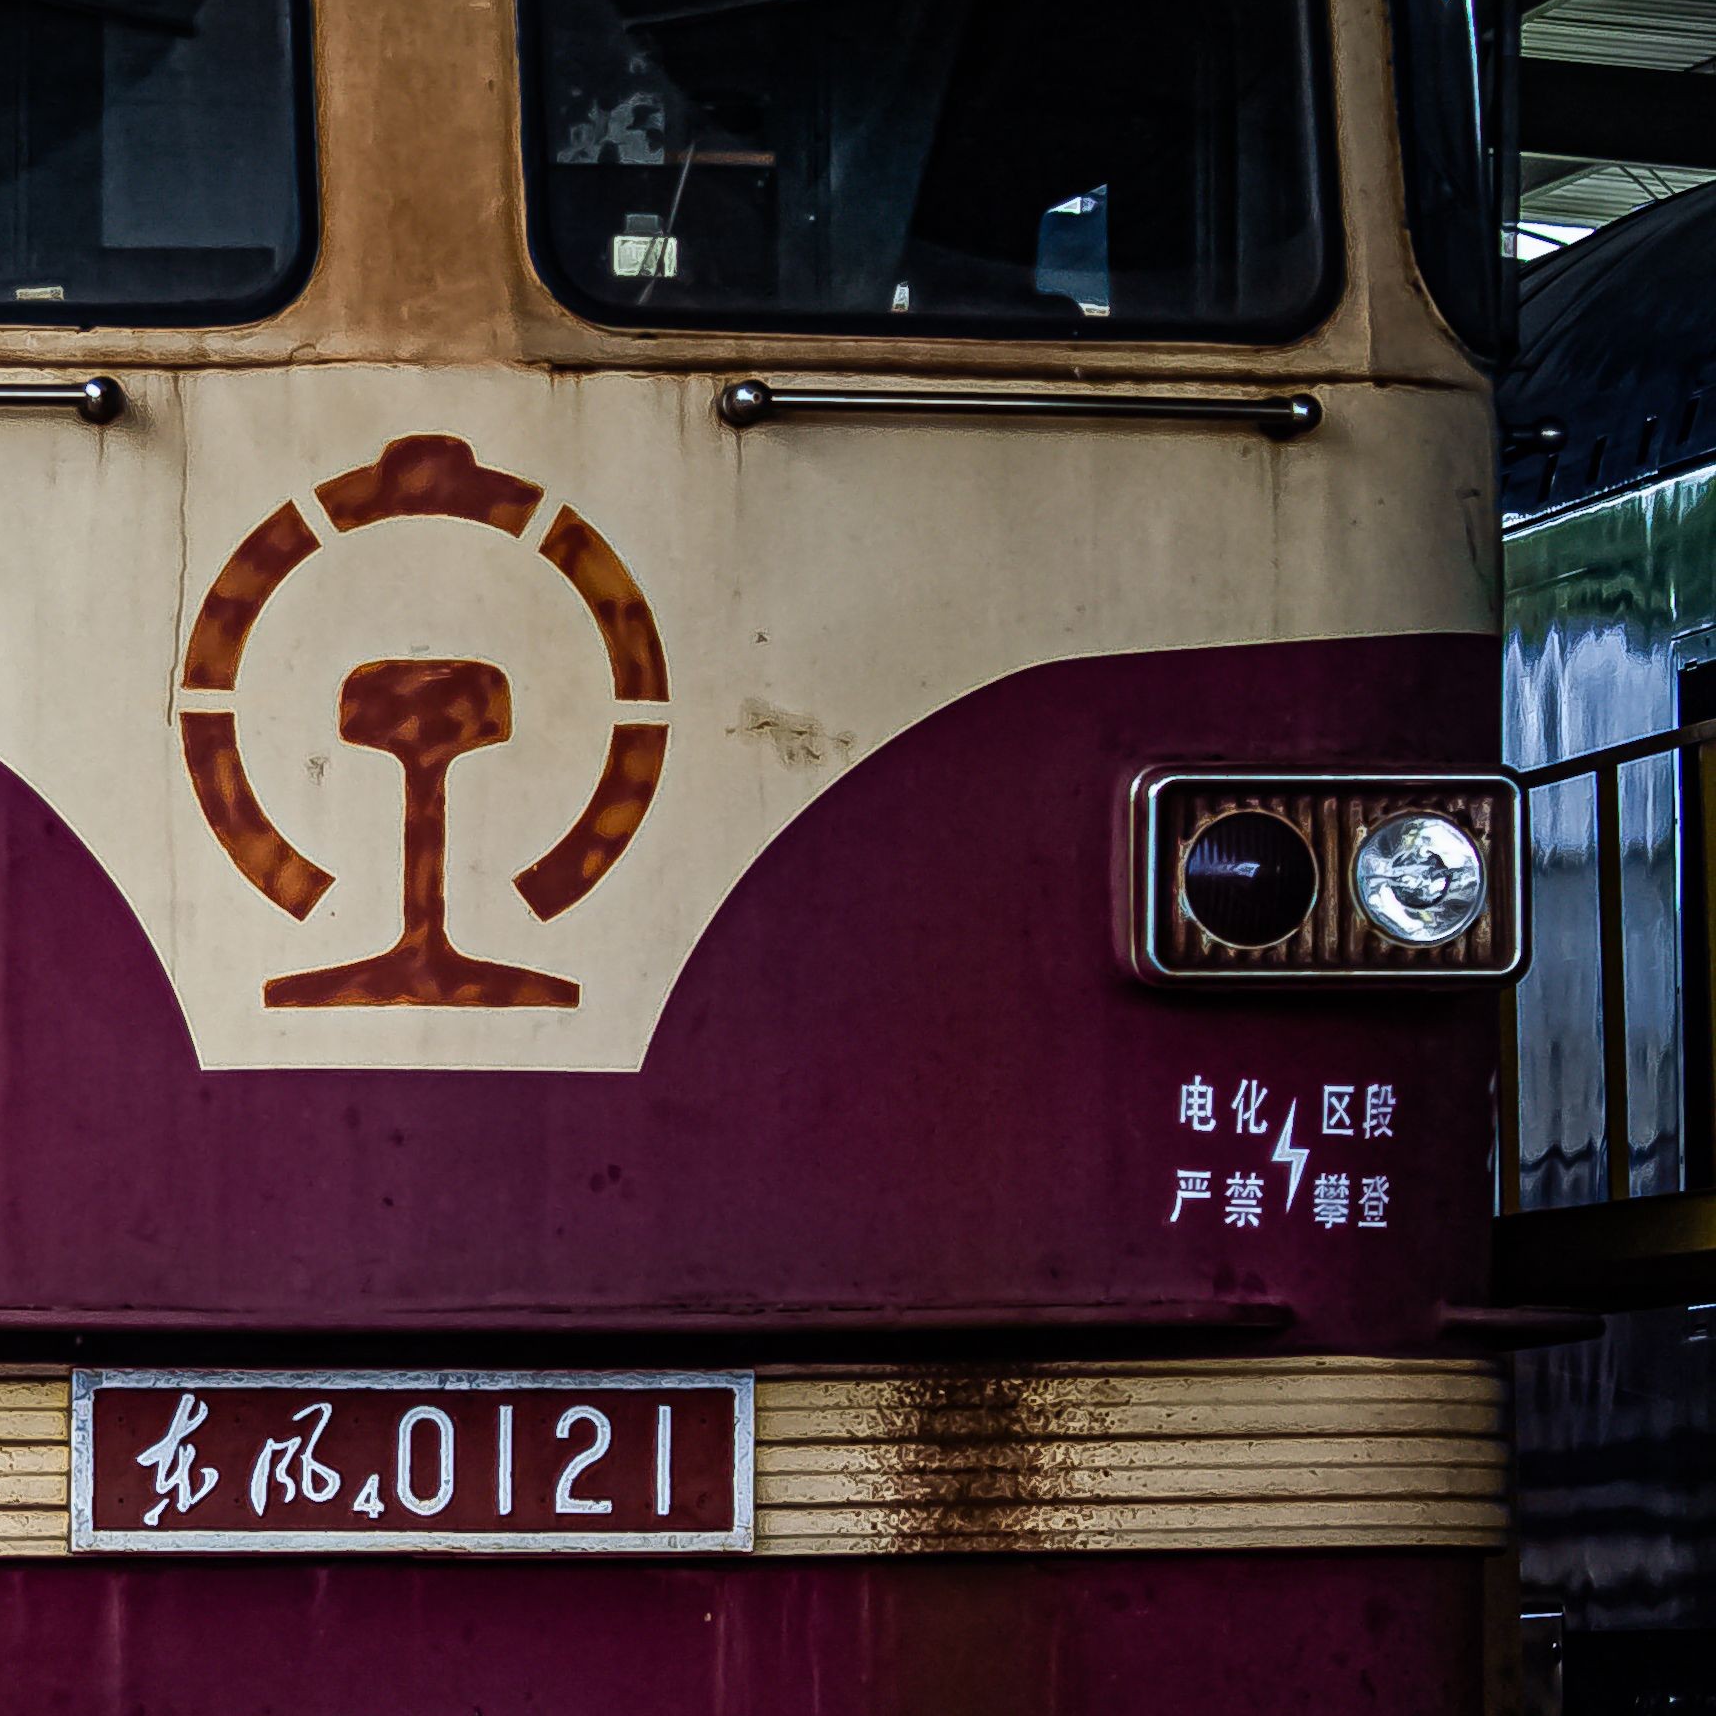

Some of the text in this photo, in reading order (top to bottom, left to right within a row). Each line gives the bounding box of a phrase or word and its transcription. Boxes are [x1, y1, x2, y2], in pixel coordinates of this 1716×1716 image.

[1179, 1075, 1397, 1139] 电化 区段
[1169, 1169, 1390, 1230] 严禁 攀登
